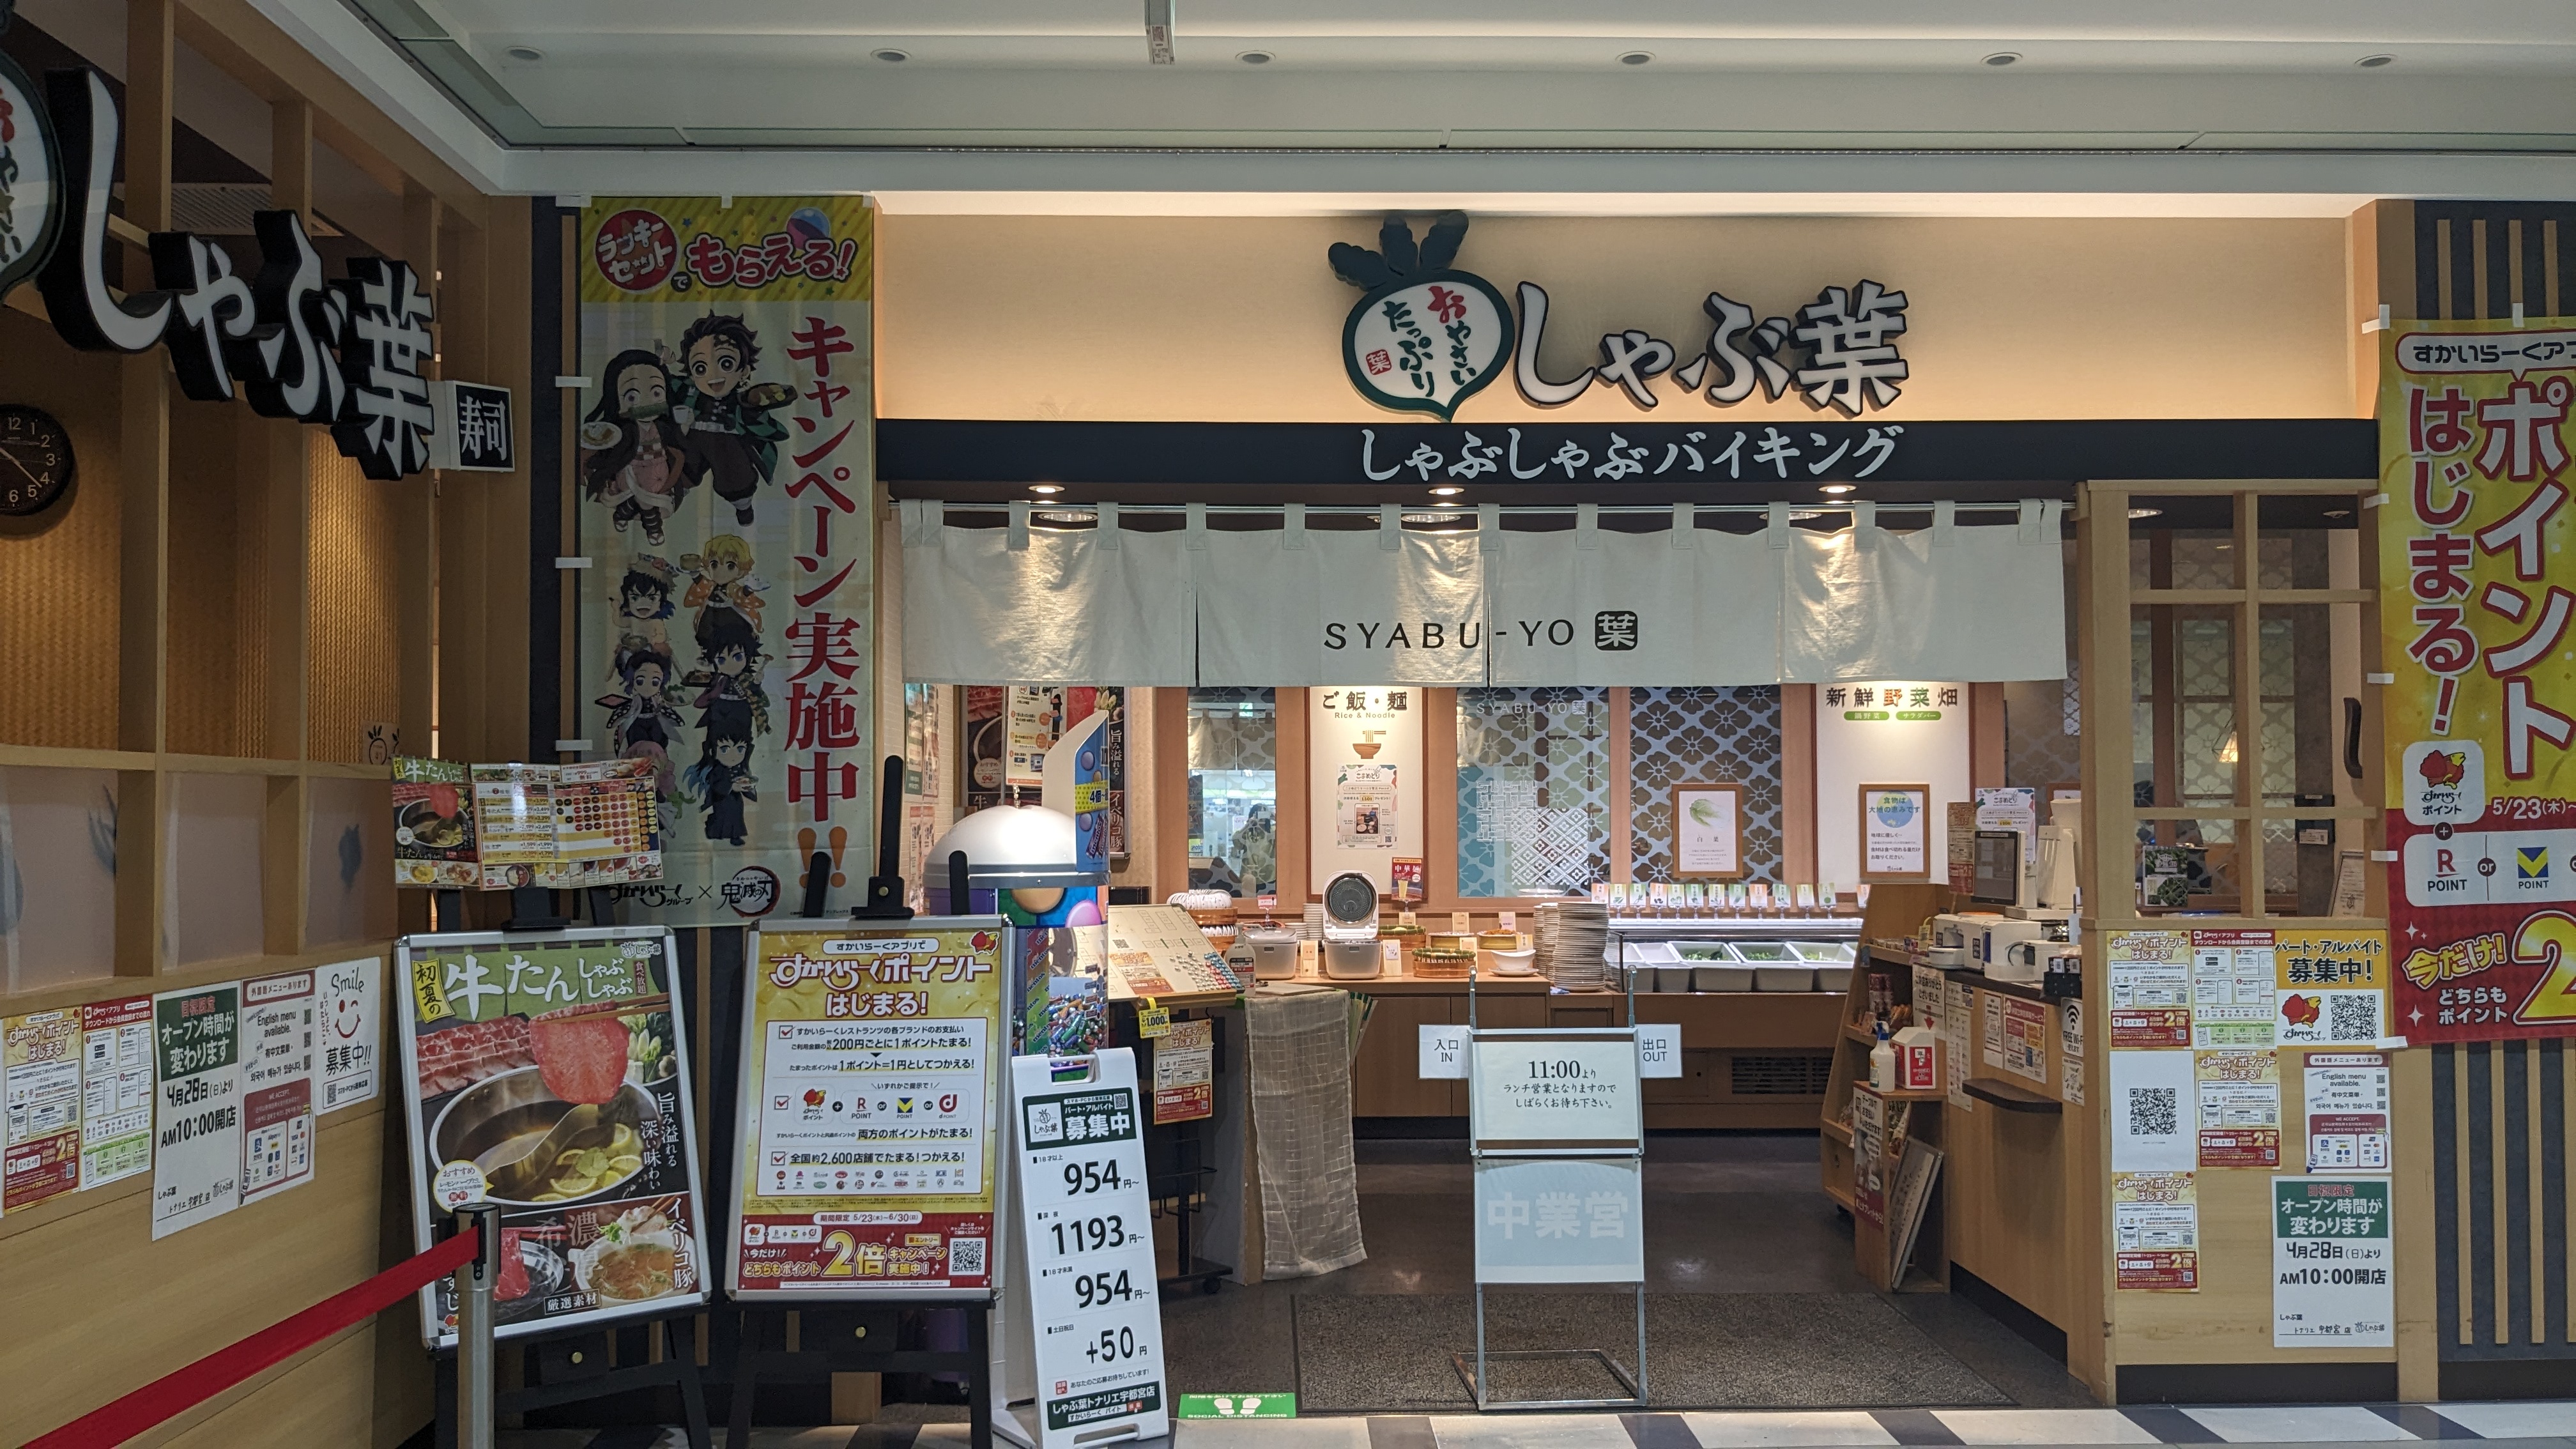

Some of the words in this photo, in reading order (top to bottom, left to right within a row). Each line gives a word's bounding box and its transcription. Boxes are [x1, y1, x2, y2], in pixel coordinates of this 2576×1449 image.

[598, 218, 664, 263] ラッキー
[609, 241, 672, 283] セット
[82, 70, 434, 479] しゃぶ葉
[1427, 285, 1476, 386] おやさい
[1381, 300, 1434, 398] たっぷり
[1515, 279, 1909, 417] しゃぶ葉
[1368, 350, 1391, 375] 葉
[8, 417, 21, 430] 12
[31, 422, 34, 435] 1
[459, 396, 508, 461] 寿司
[41, 435, 50, 447] 2
[46, 454, 55, 466] 3
[1361, 425, 1905, 482] しゃぶしゃぶバイキング
[40, 472, 50, 484] 4
[9, 490, 19, 502] 6
[27, 485, 37, 497] 5
[1324, 620, 1574, 650] SYABU-YO
[1597, 613, 1636, 648] 葉
[1322, 691, 1407, 711] ご飯・麺
[1825, 687, 1958, 708] 新鮮野菜畑
[1869, 806, 1920, 814] 大地の恵みです
[2423, 805, 2462, 816] ポイント
[2480, 862, 2494, 872] or
[2427, 879, 2467, 892] POINT
[2518, 880, 2549, 889] POINT
[717, 880, 774, 910] 鬼滅の刃
[836, 940, 926, 951] すかいらーくアプリで
[2275, 939, 2383, 955] パート・アルバイト
[2131, 950, 2172, 960] はじまる!
[579, 958, 625, 979] しゃぶ
[770, 953, 992, 992] すかいらーくポイント
[2288, 958, 2373, 984] 募集中!
[331, 967, 365, 997] Smile
[635, 961, 647, 995] 食べ放題
[415, 964, 442, 1015] 初夏の
[444, 954, 579, 1022] 牛たん
[587, 977, 633, 998] しゃぶ
[2439, 987, 2507, 1004] どちらも
[826, 992, 928, 1018] はじまる!
[257, 1012, 279, 1026] English
[280, 1011, 296, 1021] menu
[2439, 1008, 2508, 1025] ポイント
[162, 1011, 235, 1046] オープン時間が
[797, 1026, 964, 1036] すかいらーくレストランツの各ブランドのお支払い
[1434, 1039, 1459, 1051] 入口
[1643, 1038, 1667, 1050] 出口
[170, 1036, 229, 1075] 変わります
[326, 1040, 372, 1077] 募集中!!
[1441, 1053, 1453, 1062] IN
[1643, 1052, 1667, 1062] OUT
[1528, 1060, 1581, 1079] 11:00
[1582, 1068, 1597, 1079] より
[2220, 1070, 2260, 1079] はじまる!
[1503, 1083, 1616, 1094] ランチ営業となりますので
[1064, 1103, 1114, 1114] パート・アルバイト
[1515, 1098, 1613, 1109] しばらくお待ち下さい。
[657, 1091, 680, 1169] 旨み溢れる
[858, 1128, 972, 1138] 両方のポイントがたまる!
[1034, 1123, 1058, 1134] しゃぶ葉
[1065, 1112, 1130, 1140] 募集中
[640, 1119, 663, 1191] 深い味わい
[1038, 1154, 1063, 1163] 18才以上
[443, 1167, 475, 1177] おすすめ
[1064, 1159, 1121, 1196] 954
[2137, 1191, 2177, 1200] はじまる!
[2308, 1184, 2354, 1197] 日祝限定
[2281, 1198, 2383, 1215] オープン時間が
[2290, 1217, 2375, 1235] 変わります
[1051, 1215, 1124, 1255] 1193
[666, 1197, 694, 1291] イベリコ豚
[823, 1230, 887, 1277] 2倍
[888, 1247, 947, 1260] キャンペーン
[743, 1261, 821, 1277] どちらもポイント
[1075, 1269, 1133, 1308] 954
[547, 1293, 599, 1310] 厳選素材
[1053, 1324, 1074, 1334] 土日祝日
[1085, 1326, 1134, 1364] +50
[1139, 1345, 1147, 1356] 円
[1053, 1385, 1155, 1414] しゃぶ葉トナリエ宇都宮店
[1070, 1409, 1101, 1420] すかいらーく
